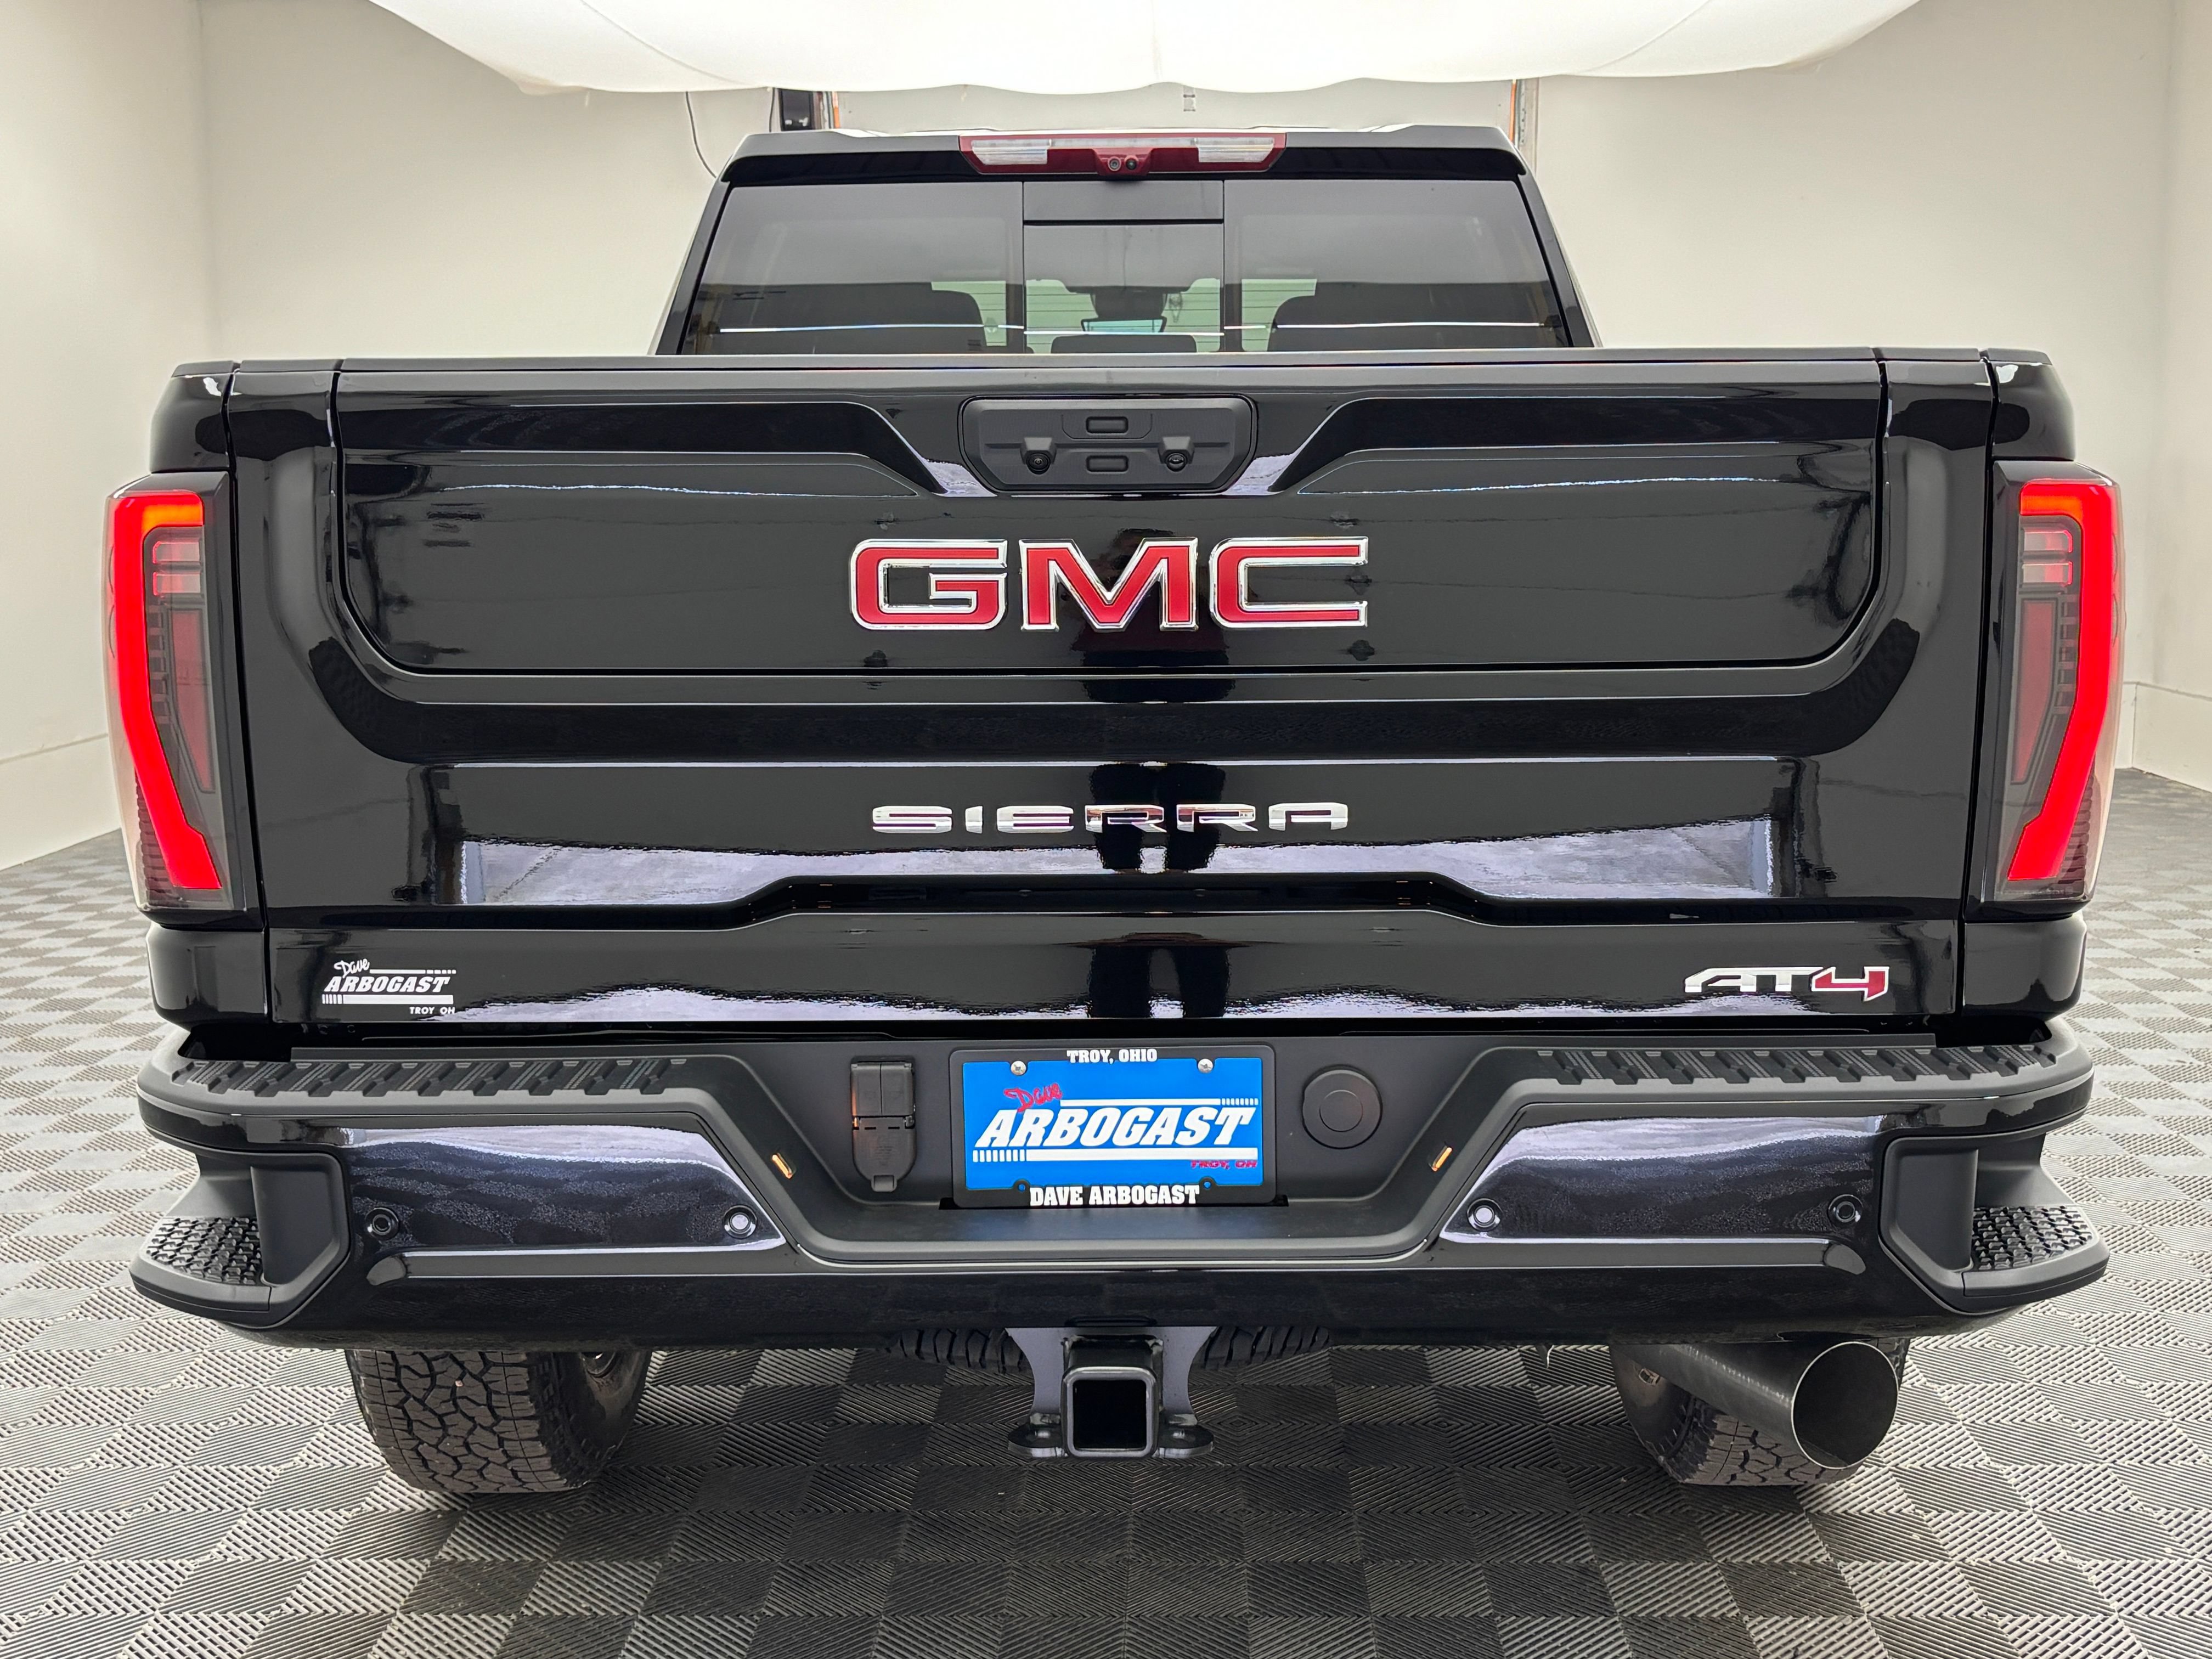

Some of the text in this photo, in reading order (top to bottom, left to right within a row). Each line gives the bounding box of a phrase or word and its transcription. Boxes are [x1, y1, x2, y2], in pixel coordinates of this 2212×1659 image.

[849, 537, 1369, 631] GMC
[872, 802, 1350, 834] SIERRA
[334, 958, 370, 979] Dave
[324, 976, 450, 992] ARBOGAST
[1684, 966, 1889, 1002] AT4
[1066, 1048, 1158, 1064] TROY, OHIO
[1004, 1083, 1062, 1112] Dave
[975, 1107, 1256, 1147] ARBOGAST
[1235, 1160, 1257, 1168] OH
[1030, 1185, 1200, 1206] DAVE ARBOGAST
